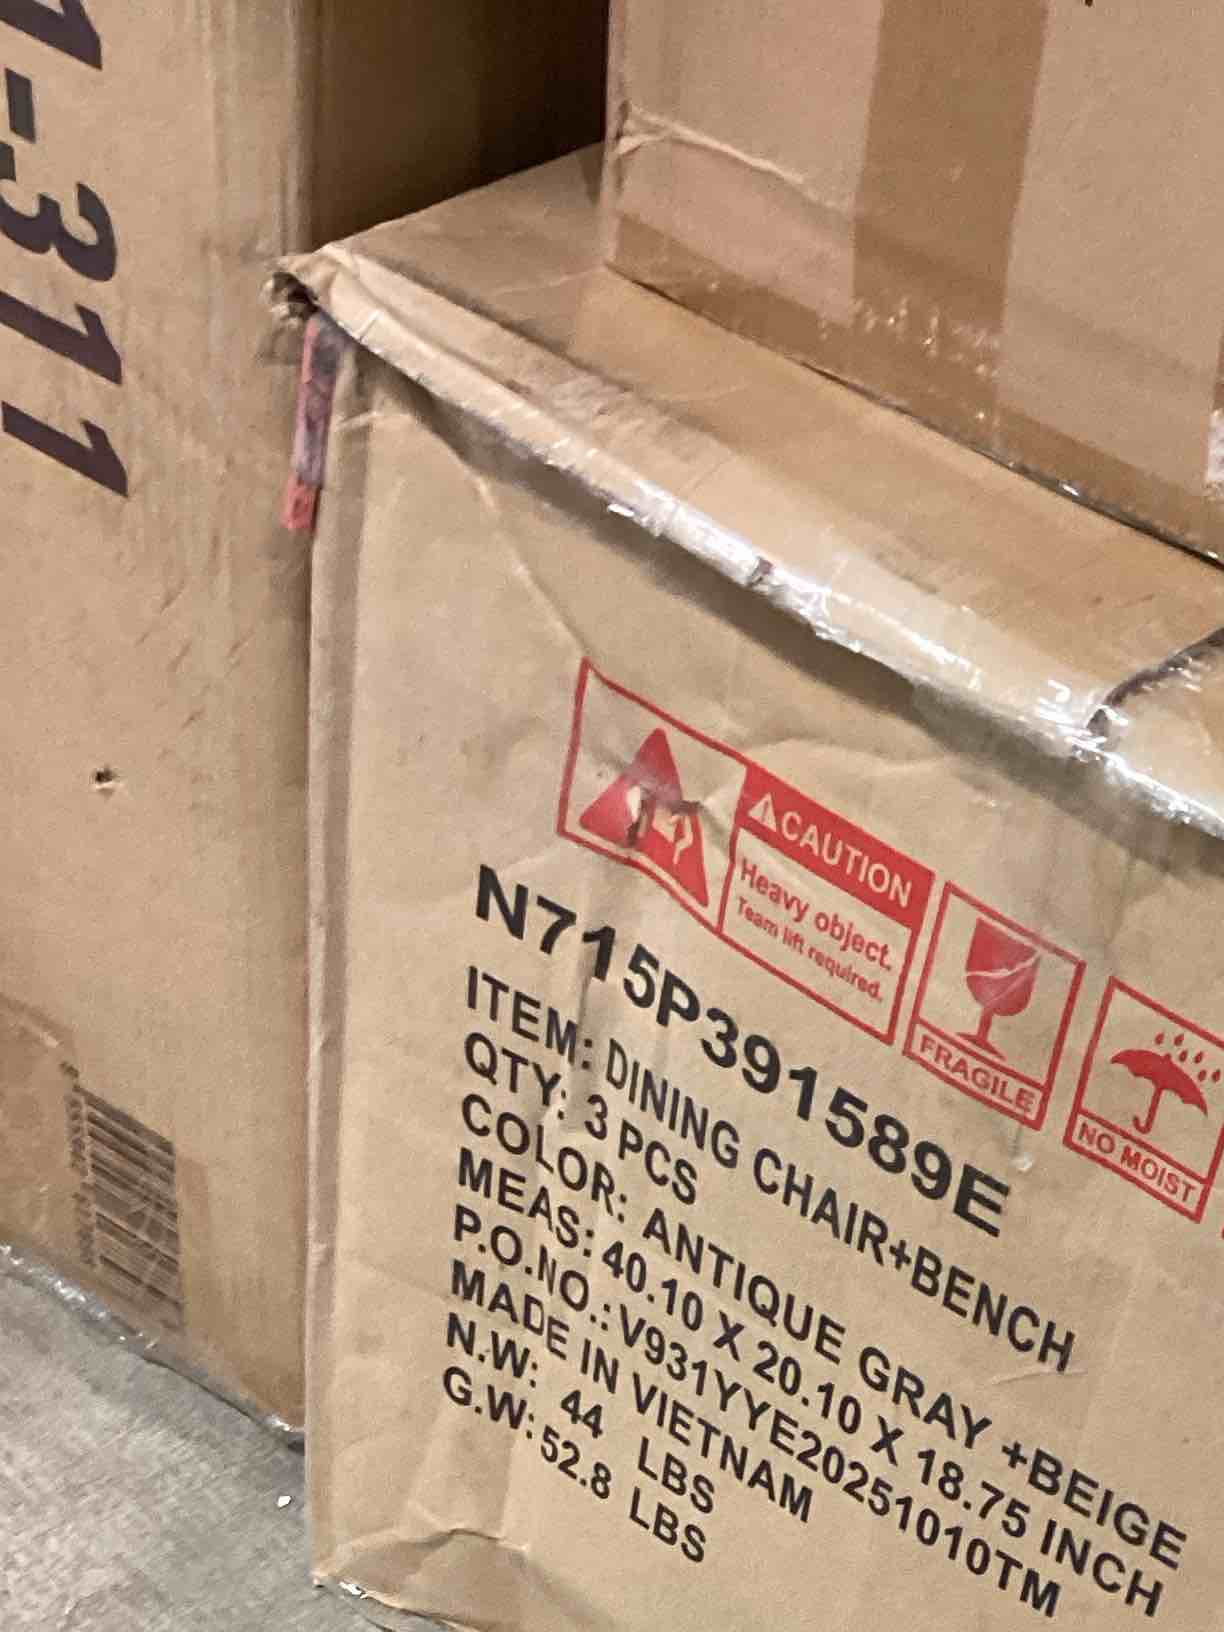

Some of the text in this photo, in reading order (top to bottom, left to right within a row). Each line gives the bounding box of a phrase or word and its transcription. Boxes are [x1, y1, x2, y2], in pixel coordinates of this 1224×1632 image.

[738, 897, 884, 1003] Team lift required.
[740, 858, 892, 970] Heavy object.
[781, 811, 912, 908] CAUTION
[464, 1032, 698, 1205] QTY: 3 PCS
[475, 864, 1011, 1238] N715P391589E
[919, 1034, 1036, 1114] FRAGILE
[466, 965, 1076, 1373] ITEM: DINING CHAIR+BENCH
[1078, 1121, 1196, 1204] NO MOIST
[447, 1312, 715, 1514] N.W: 44 LBS
[451, 1259, 812, 1523] MADE IN VIETNAM
[458, 1147, 1163, 1618] MEAS: 40.10 X 20.10 X 18.75 INCH
[461, 1094, 1187, 1570] COLOR: ANTIQUE GRAY +BEIGE
[443, 1366, 706, 1563] G.W: 52.8 LBS
[619, 1303, 1061, 1618] V931YYE20251010TM
